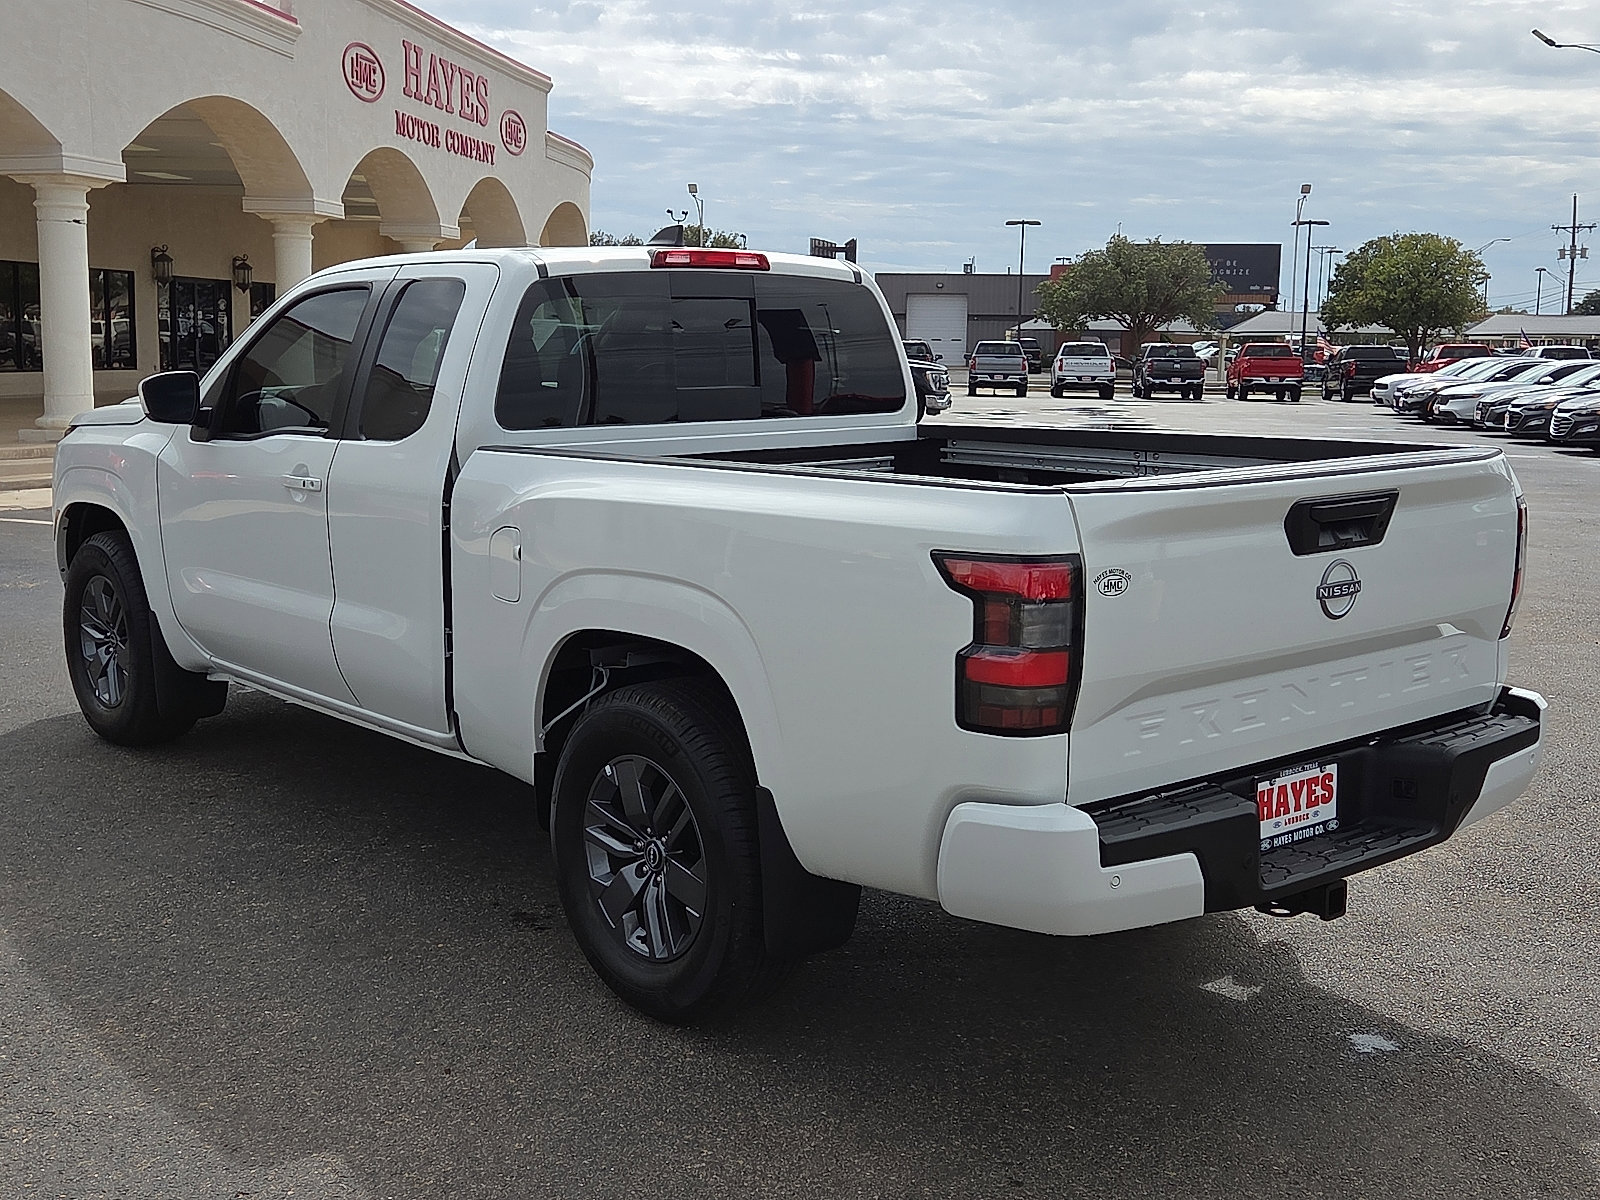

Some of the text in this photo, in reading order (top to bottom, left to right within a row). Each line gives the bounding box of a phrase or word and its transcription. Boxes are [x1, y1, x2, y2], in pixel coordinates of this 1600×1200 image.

[351, 53, 376, 93] HMC
[402, 40, 489, 127] HAYES
[395, 110, 496, 166] MOTOR COMPANY
[505, 117, 522, 149] HMC
[1093, 570, 1108, 585] HAYES
[1108, 568, 1125, 576] MOTOR
[1103, 578, 1123, 593] HMC
[1320, 582, 1361, 598] NISSAN
[1125, 645, 1468, 757] FRONTIER
[1258, 772, 1334, 821] HAYES
[1273, 833, 1292, 848] HAYES
[1294, 827, 1314, 842] MOTOR
